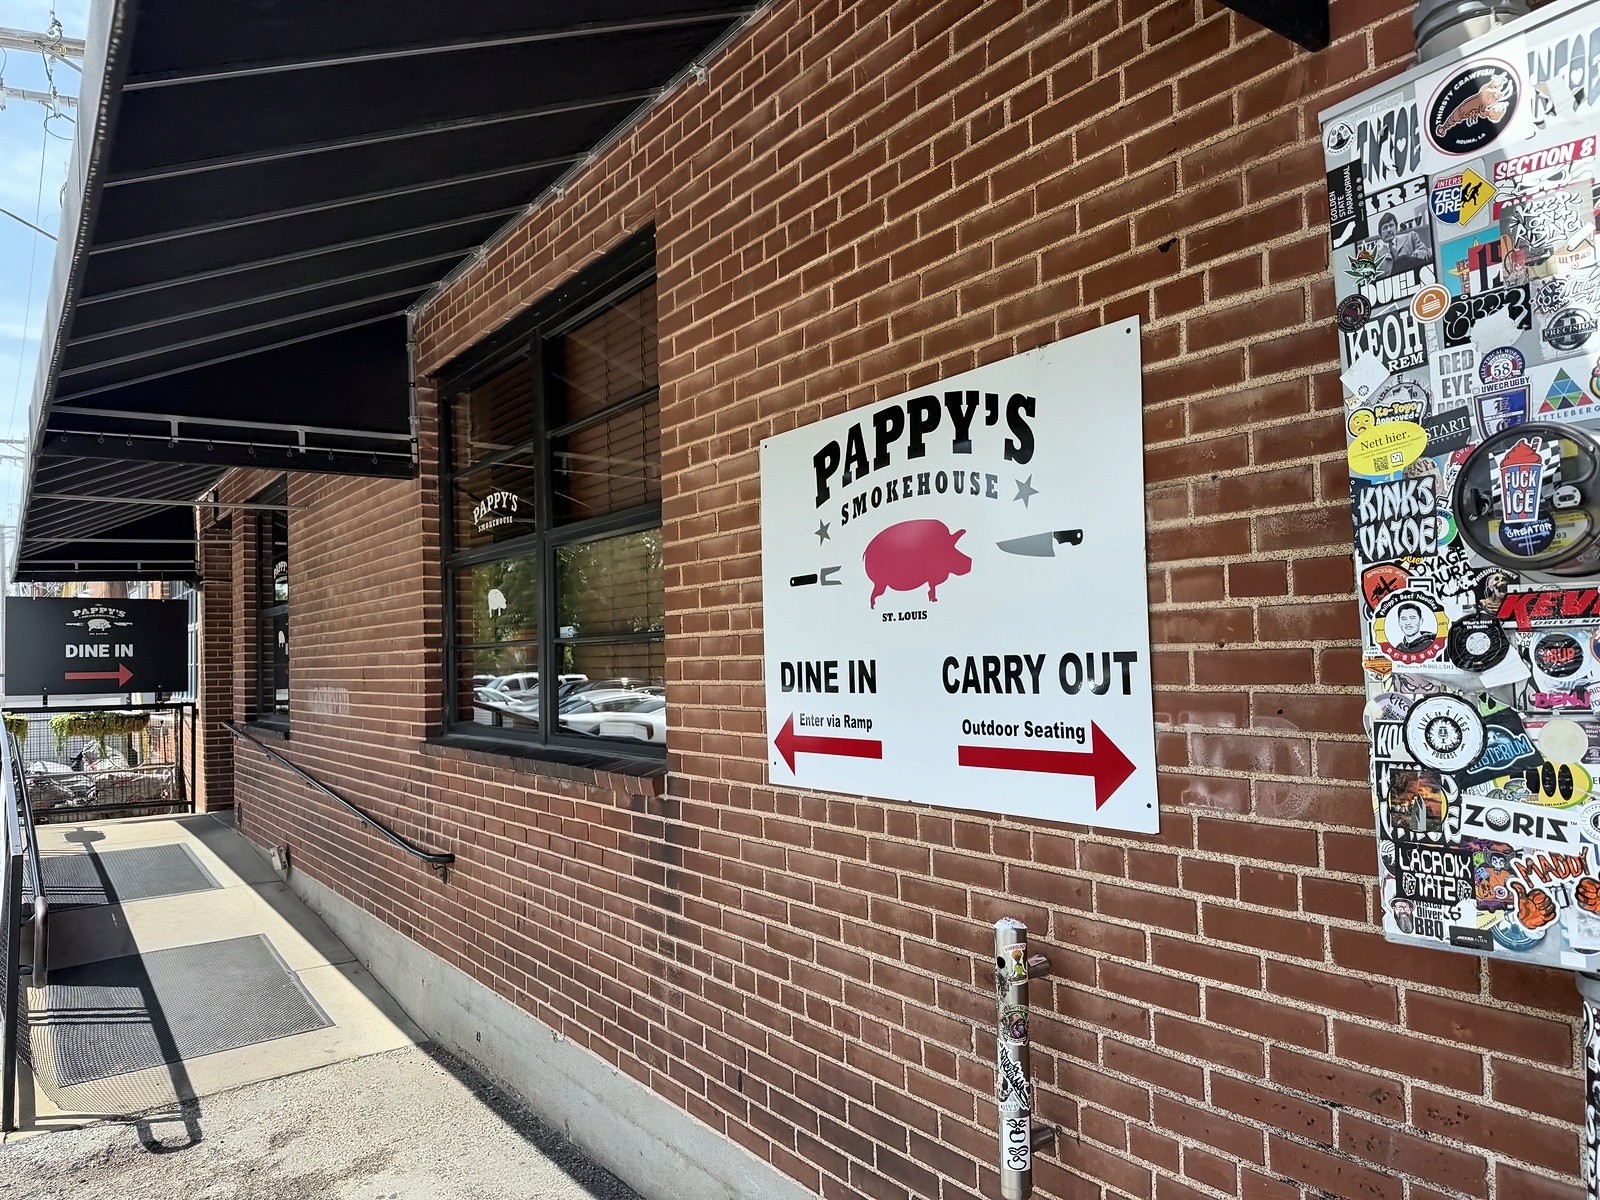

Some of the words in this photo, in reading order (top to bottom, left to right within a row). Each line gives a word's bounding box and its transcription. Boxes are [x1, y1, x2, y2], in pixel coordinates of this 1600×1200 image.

[1436, 90, 1454, 124] THIRSTY
[1454, 68, 1496, 90] CRAWFISH
[1495, 143, 1576, 180] SECTION
[1580, 138, 1594, 157] 8
[1343, 165, 1354, 215] PARANORMAL
[1434, 187, 1462, 204] ZEC
[1329, 191, 1338, 221] GOLDEN
[1337, 195, 1346, 218] STATE
[1544, 320, 1598, 339] PRECISION
[1388, 351, 1424, 372] REM
[1439, 349, 1474, 375] RED
[1493, 363, 1510, 377] 58
[1442, 373, 1472, 398] EYE
[1481, 376, 1531, 393] UWECRUGBY
[812, 390, 1037, 509] PAPPY'S
[1360, 437, 1383, 451] Nett
[1385, 431, 1411, 444] hier.
[1504, 469, 1537, 490] FUCK
[472, 491, 519, 525] PAPPY'S
[841, 470, 998, 526] SMOKEHOUSE
[1358, 476, 1435, 524] KINKS
[1505, 490, 1536, 514] ICE
[478, 515, 513, 532] SMOKEHOUSE
[1415, 550, 1469, 577] OYAGE
[72, 607, 126, 618] PAPPY'S
[882, 612, 897, 622] ST.
[898, 610, 928, 621] LOUIS
[65, 644, 110, 658] DINE
[115, 644, 134, 658] IN
[780, 660, 839, 694] DINE
[848, 659, 877, 694] IN
[942, 653, 1046, 695] CARRY
[1058, 650, 1138, 696] OUT
[799, 713, 825, 728] Enter
[826, 714, 841, 728] via
[843, 715, 873, 731] Ramp
[962, 719, 1020, 738] Outdoor
[1024, 721, 1086, 744] Seating
[1417, 713, 1432, 731] LIVE
[1454, 713, 1470, 733] LEGS
[1431, 751, 1457, 760] PODCAST
[1470, 736, 1531, 771] TERIUM
[1398, 847, 1472, 879] LACROIX
[1513, 846, 1591, 889] MADDY
[1414, 917, 1444, 941] BBQ
